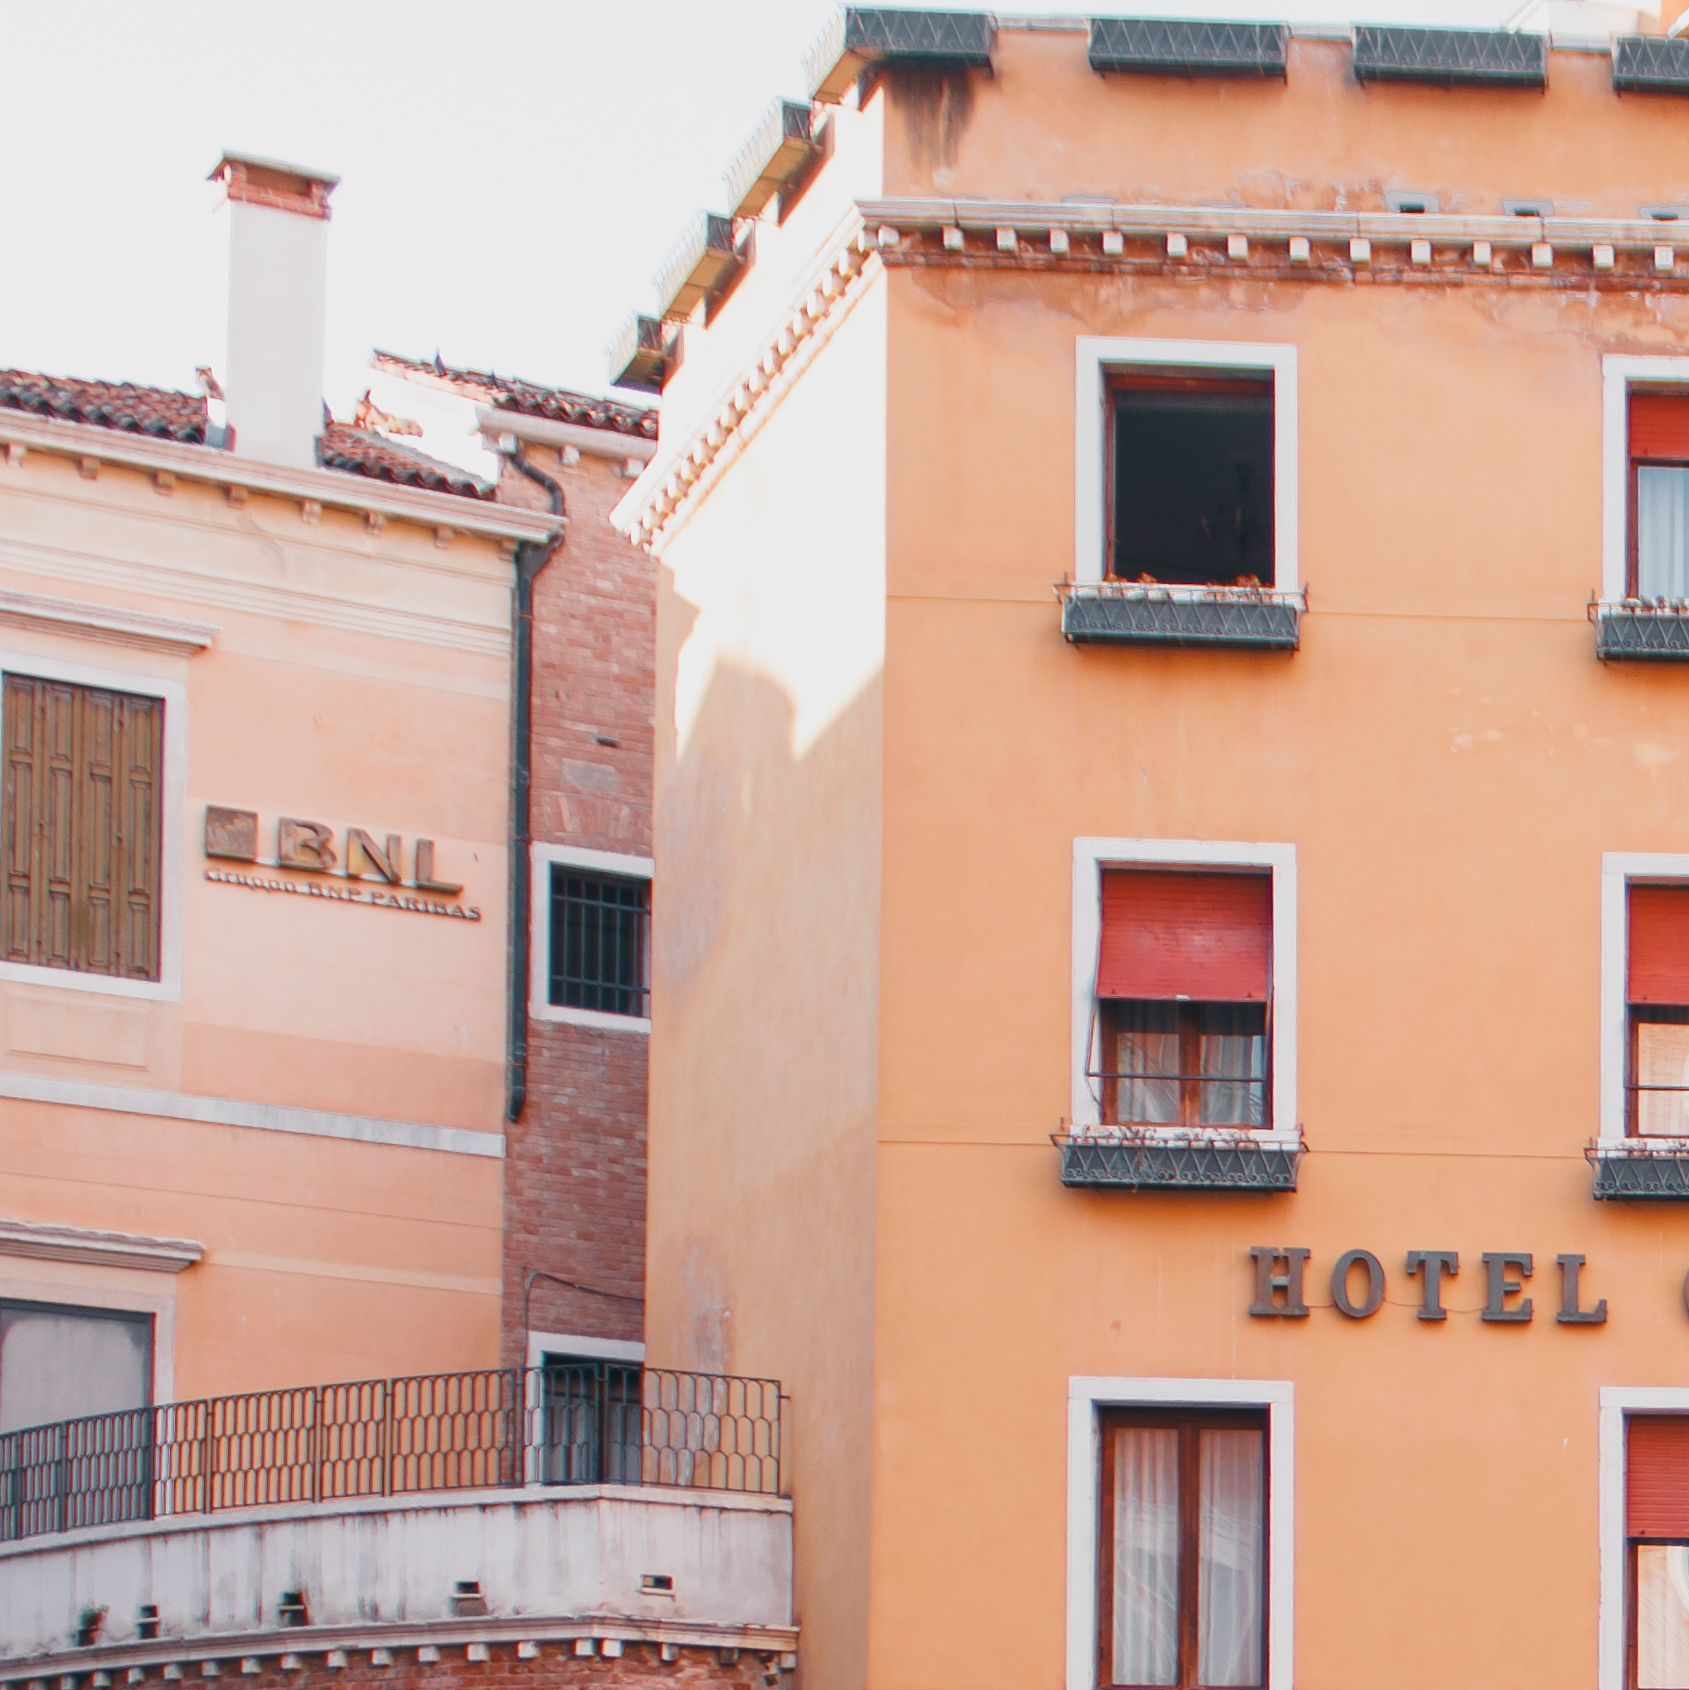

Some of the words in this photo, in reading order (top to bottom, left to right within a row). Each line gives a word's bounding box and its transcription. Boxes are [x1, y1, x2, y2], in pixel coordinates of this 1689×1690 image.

[276, 815, 464, 897] BNL
[304, 880, 363, 904] BNP
[368, 890, 482, 922] PARIBAS
[1248, 1245, 1607, 1323] HOTEL
